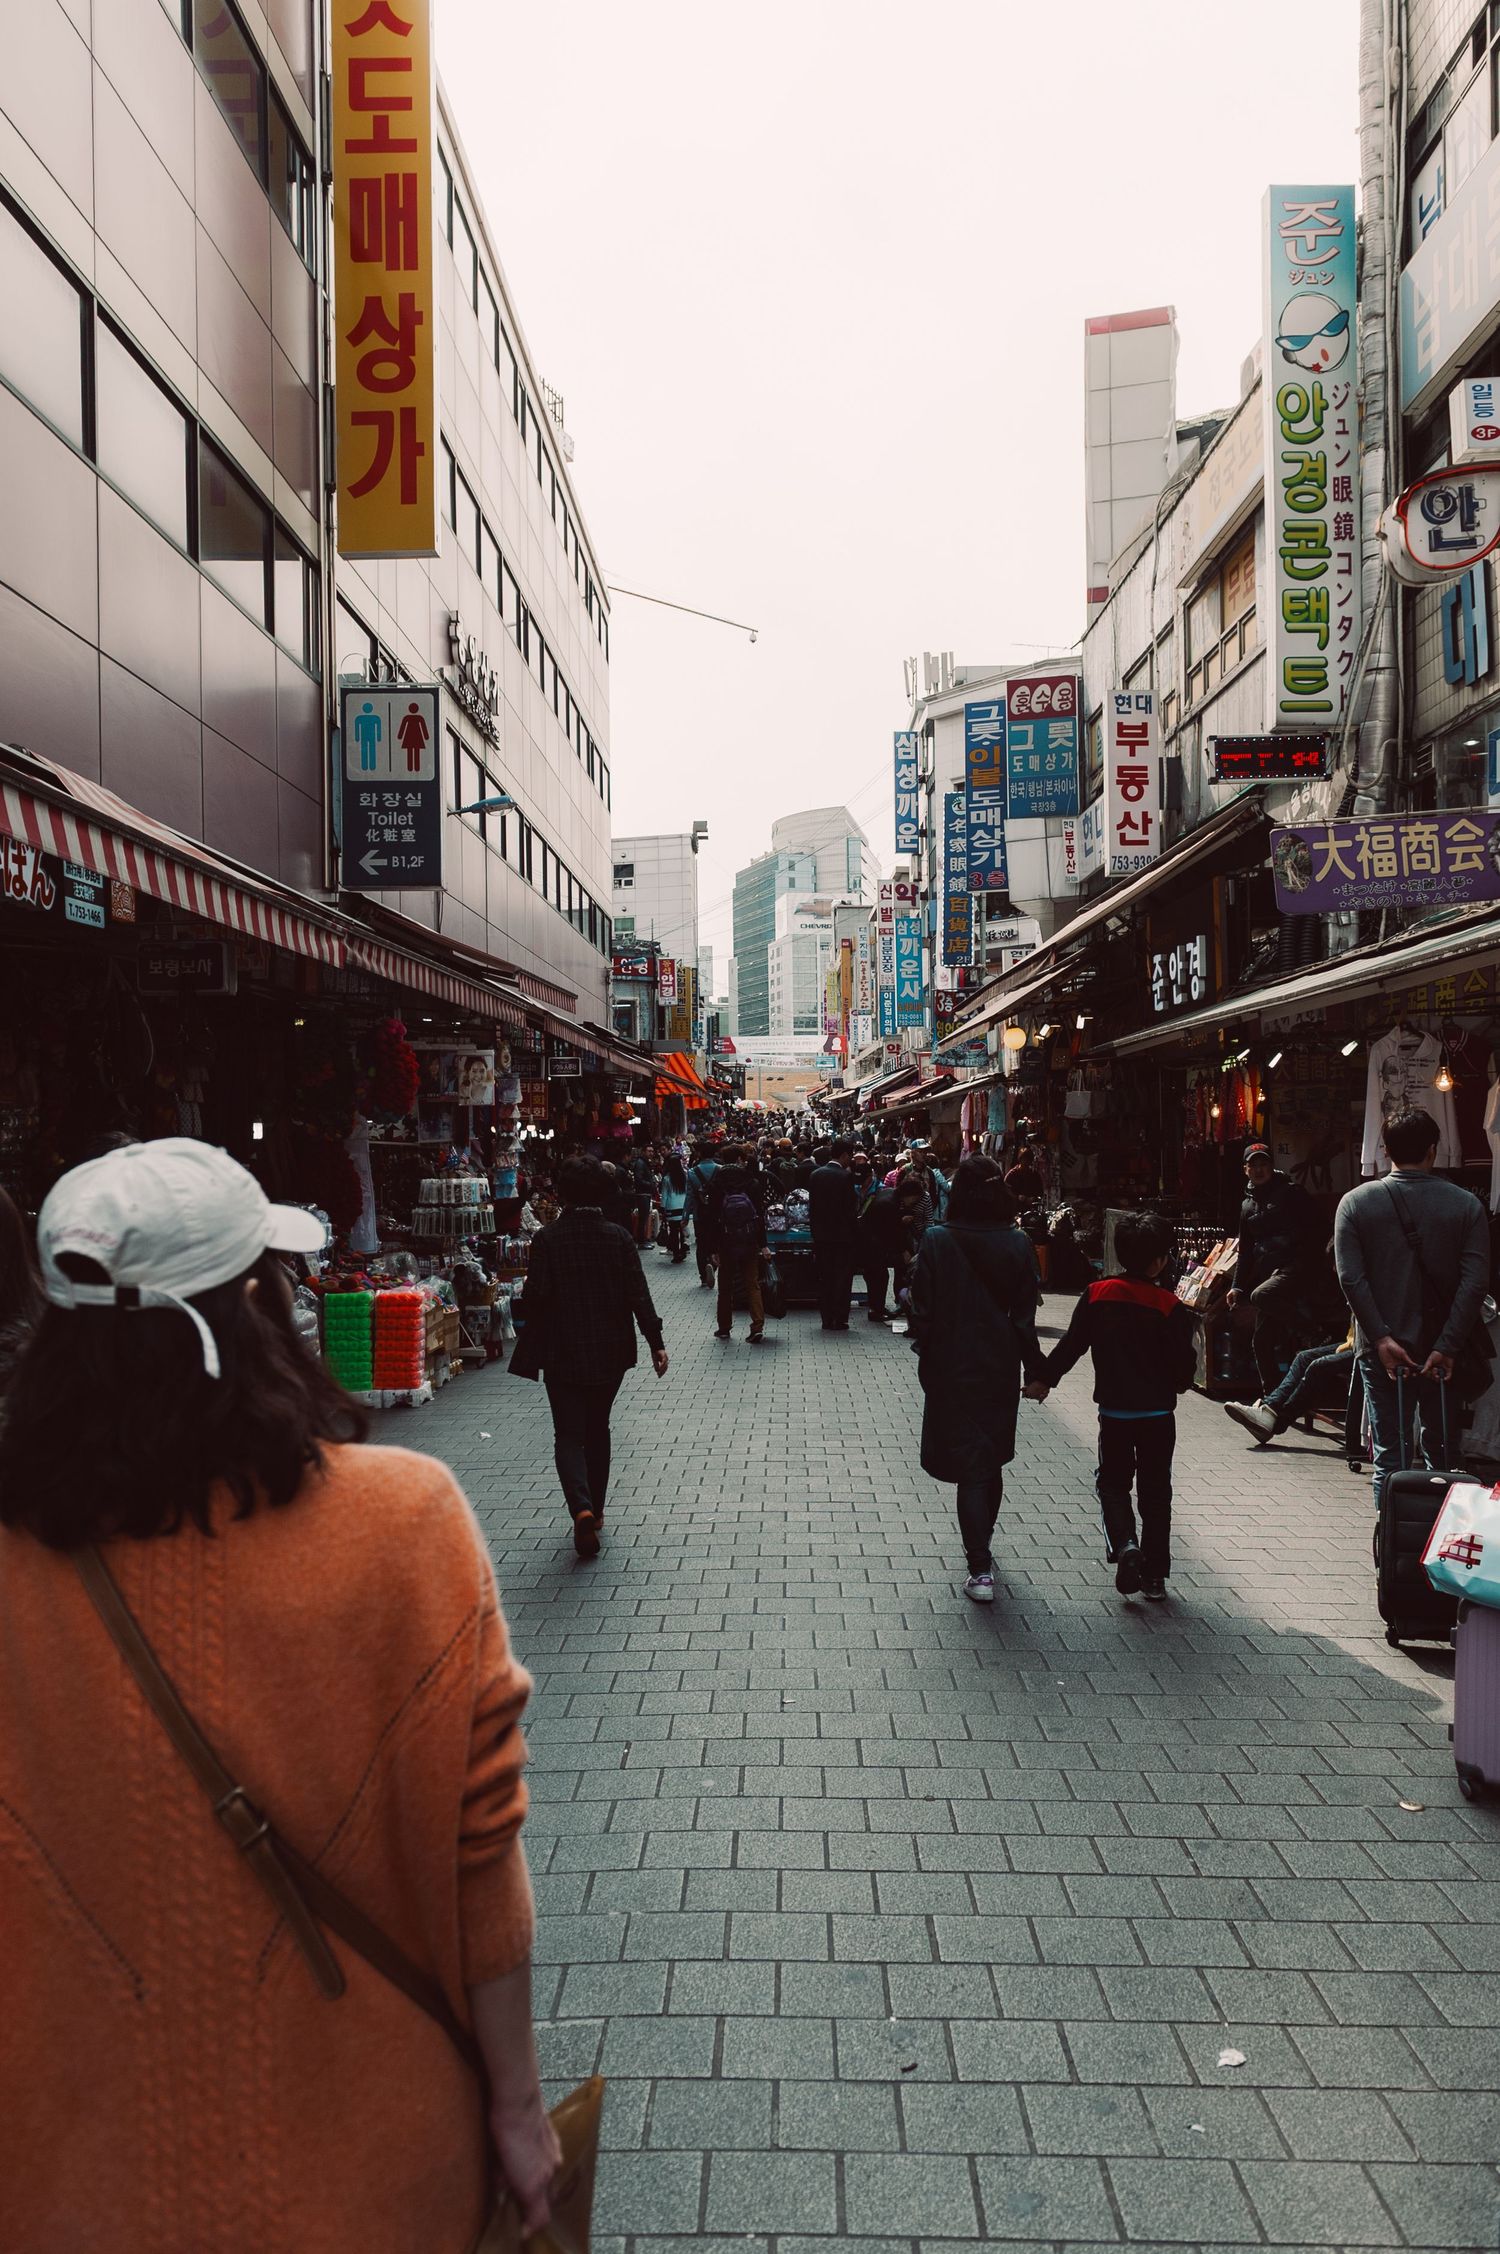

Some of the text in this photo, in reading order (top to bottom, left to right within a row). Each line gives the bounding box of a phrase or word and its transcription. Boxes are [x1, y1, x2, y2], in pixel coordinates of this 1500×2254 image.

[1278, 199, 1345, 266] 준
[1287, 270, 1335, 286] ジュン
[1476, 428, 1497, 438] 3F
[1276, 380, 1333, 713] 안경콘택트
[1114, 694, 1153, 715] 현대
[1010, 721, 1074, 751] 그릇
[1013, 752, 1073, 772] 도매상가
[896, 733, 919, 849] 삼성까운
[1115, 721, 1153, 846] 부동산
[359, 792, 422, 807] 화장실
[368, 811, 414, 826] Toilet
[365, 829, 416, 842] 化粧室
[1064, 830, 1077, 874] 부동산
[1312, 817, 1486, 882] 大福商会
[391, 855, 425, 868] B1,2F
[969, 871, 1006, 888] 3층
[880, 884, 892, 923] 신발
[895, 883, 919, 907] 약
[1415, 890, 1461, 904] キムチ
[897, 920, 921, 935] 삼성
[899, 938, 921, 1000] 까운사
[957, 955, 970, 963] 2F
[1152, 935, 1204, 1012] 준안경
